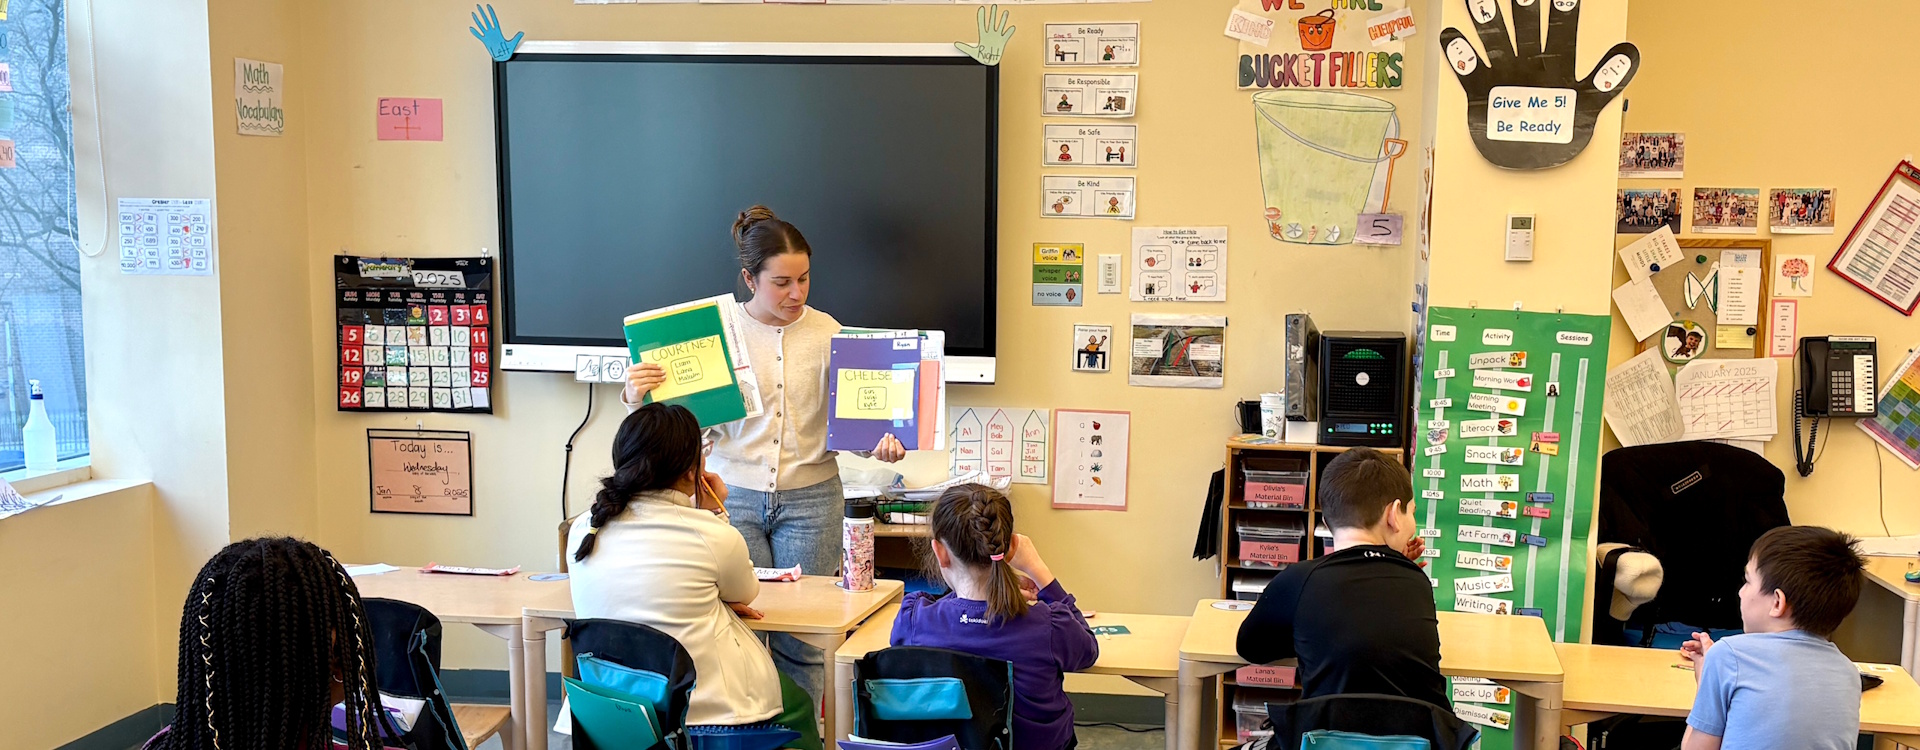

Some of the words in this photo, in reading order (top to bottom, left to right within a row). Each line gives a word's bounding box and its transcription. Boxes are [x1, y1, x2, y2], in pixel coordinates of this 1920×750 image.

[1228, 14, 1272, 39] KIND
[1368, 16, 1414, 40] HELPFUL
[490, 41, 510, 58] Left
[978, 45, 1000, 64] Right
[244, 63, 269, 85] Math
[1238, 52, 1325, 88] BUCKET
[1328, 51, 1402, 88] FILLERS
[1077, 78, 1110, 88] Responsible
[380, 99, 419, 116] East
[1493, 96, 1521, 108] Give
[1528, 96, 1547, 108] Me
[1554, 96, 1567, 108] 5!
[235, 98, 284, 128] Vocabulary
[1497, 121, 1513, 132] Be
[1520, 120, 1561, 135] Ready
[1370, 219, 1392, 236] 5
[415, 272, 461, 286] 2025
[434, 309, 442, 322] 2
[456, 309, 464, 321] 3
[476, 309, 483, 320] 4
[349, 330, 357, 341] 5
[369, 328, 378, 341] 6
[389, 330, 399, 342] 7
[434, 328, 443, 343] 9
[454, 330, 466, 342] 10
[473, 332, 485, 343] 11
[344, 349, 360, 361] 12
[413, 349, 426, 361] 15
[432, 349, 445, 361] 16
[652, 337, 716, 361] COURTNEY
[366, 349, 379, 362] 13
[454, 349, 466, 362] 17
[474, 352, 487, 363] 18
[1470, 356, 1506, 365] Unpack
[674, 360, 691, 368] Liam
[344, 371, 360, 382] 19
[411, 372, 428, 386] 22
[434, 372, 448, 386] 23
[453, 372, 468, 385] 24
[473, 372, 488, 384] 25
[844, 370, 897, 381] CHELSE
[1475, 375, 1502, 384] Morning
[1690, 368, 1732, 380] JANUARY
[1734, 367, 1757, 376] 2025
[342, 391, 359, 403] 26
[367, 392, 382, 403] 27
[390, 391, 405, 402] 28
[411, 392, 426, 404] 29
[434, 393, 448, 404] 30
[454, 390, 466, 403] 31
[1470, 394, 1499, 403] Morning
[1468, 402, 1497, 412] Meeting
[1025, 428, 1040, 438] Ann
[1461, 425, 1495, 433] Literacy
[390, 440, 426, 458] Today
[1466, 450, 1497, 459] Snack
[403, 462, 449, 485] Wednesday
[1462, 478, 1493, 488] Math
[376, 486, 391, 495] Jan
[413, 485, 421, 495] 8
[444, 488, 468, 498] 2025
[1459, 507, 1491, 516] Reading
[1459, 529, 1472, 538] Art
[1475, 531, 1498, 539] Farm
[1457, 554, 1493, 566] Lunch
[1456, 580, 1491, 591] Music
[1456, 598, 1493, 612] Writing
[1478, 690, 1492, 699] Up
[1454, 708, 1488, 719] Dismissal
